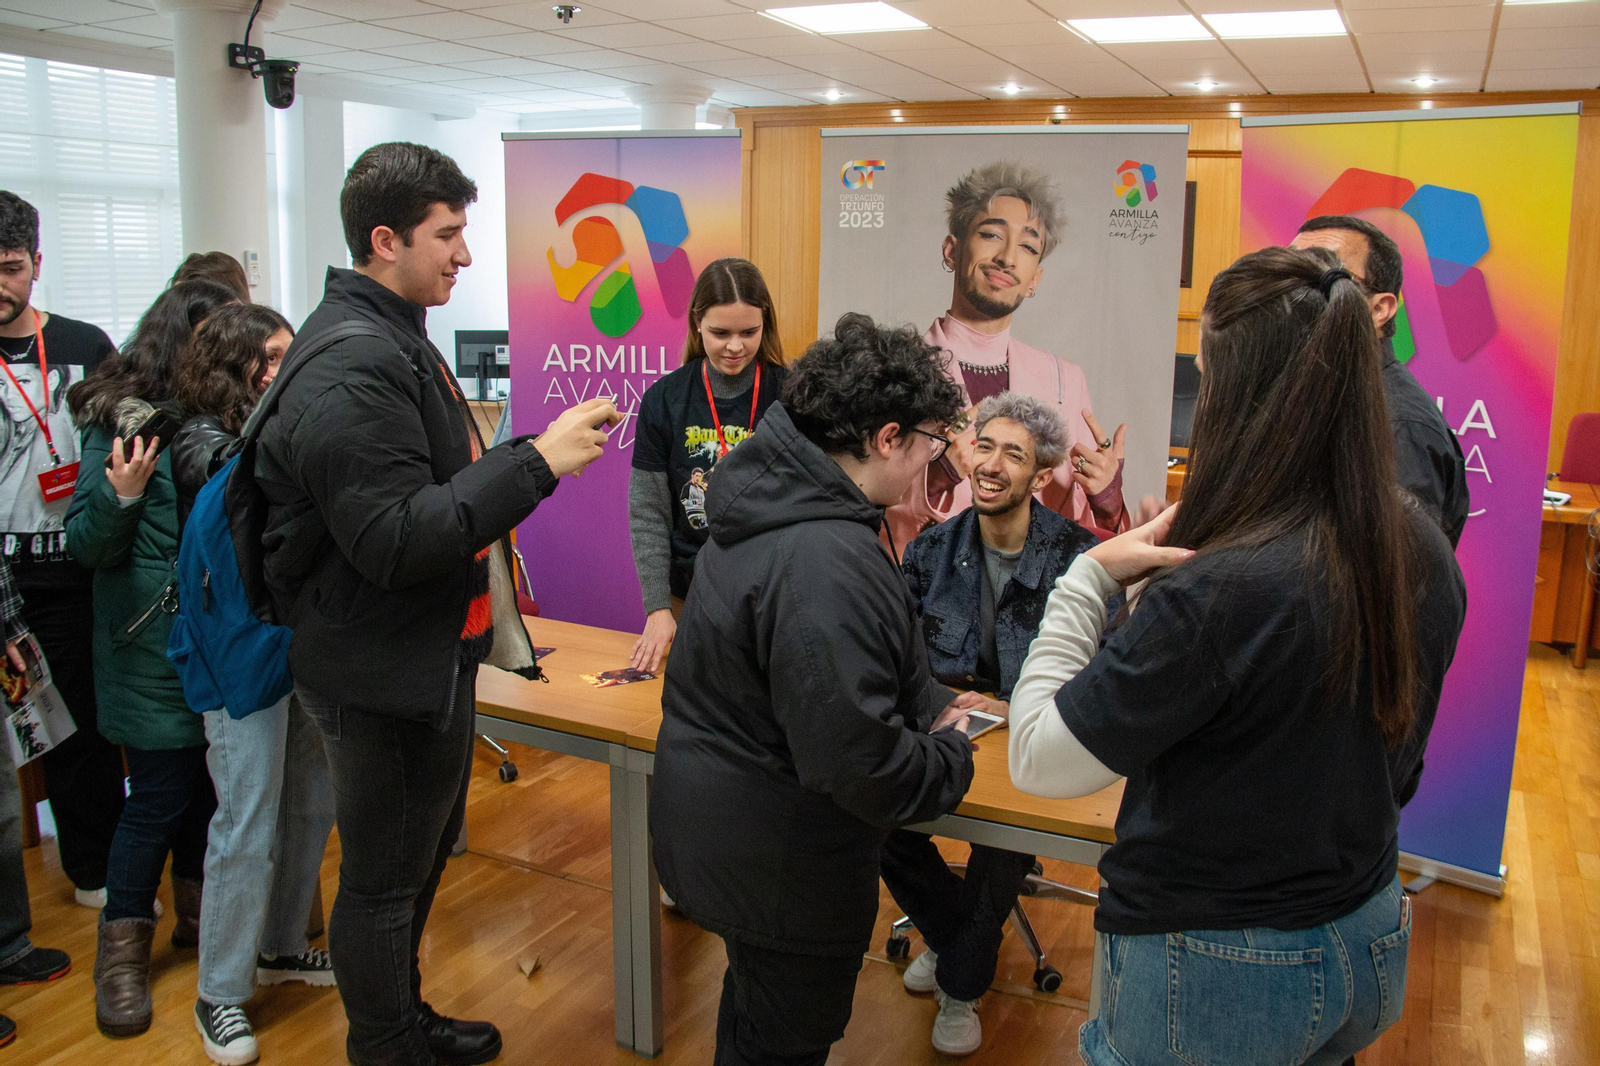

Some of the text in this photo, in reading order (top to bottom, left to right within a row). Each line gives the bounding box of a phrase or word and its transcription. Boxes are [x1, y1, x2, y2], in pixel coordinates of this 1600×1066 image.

[840, 193, 885, 202] OPERACIÓN
[840, 202, 884, 211] TRIUNFO
[839, 211, 885, 228] 2023
[1109, 209, 1159, 219] ARMILLA
[1108, 219, 1159, 229] AVANZA
[1108, 226, 1157, 246] contigo
[542, 343, 674, 375] ARMILL
[543, 377, 658, 407] AVAN
